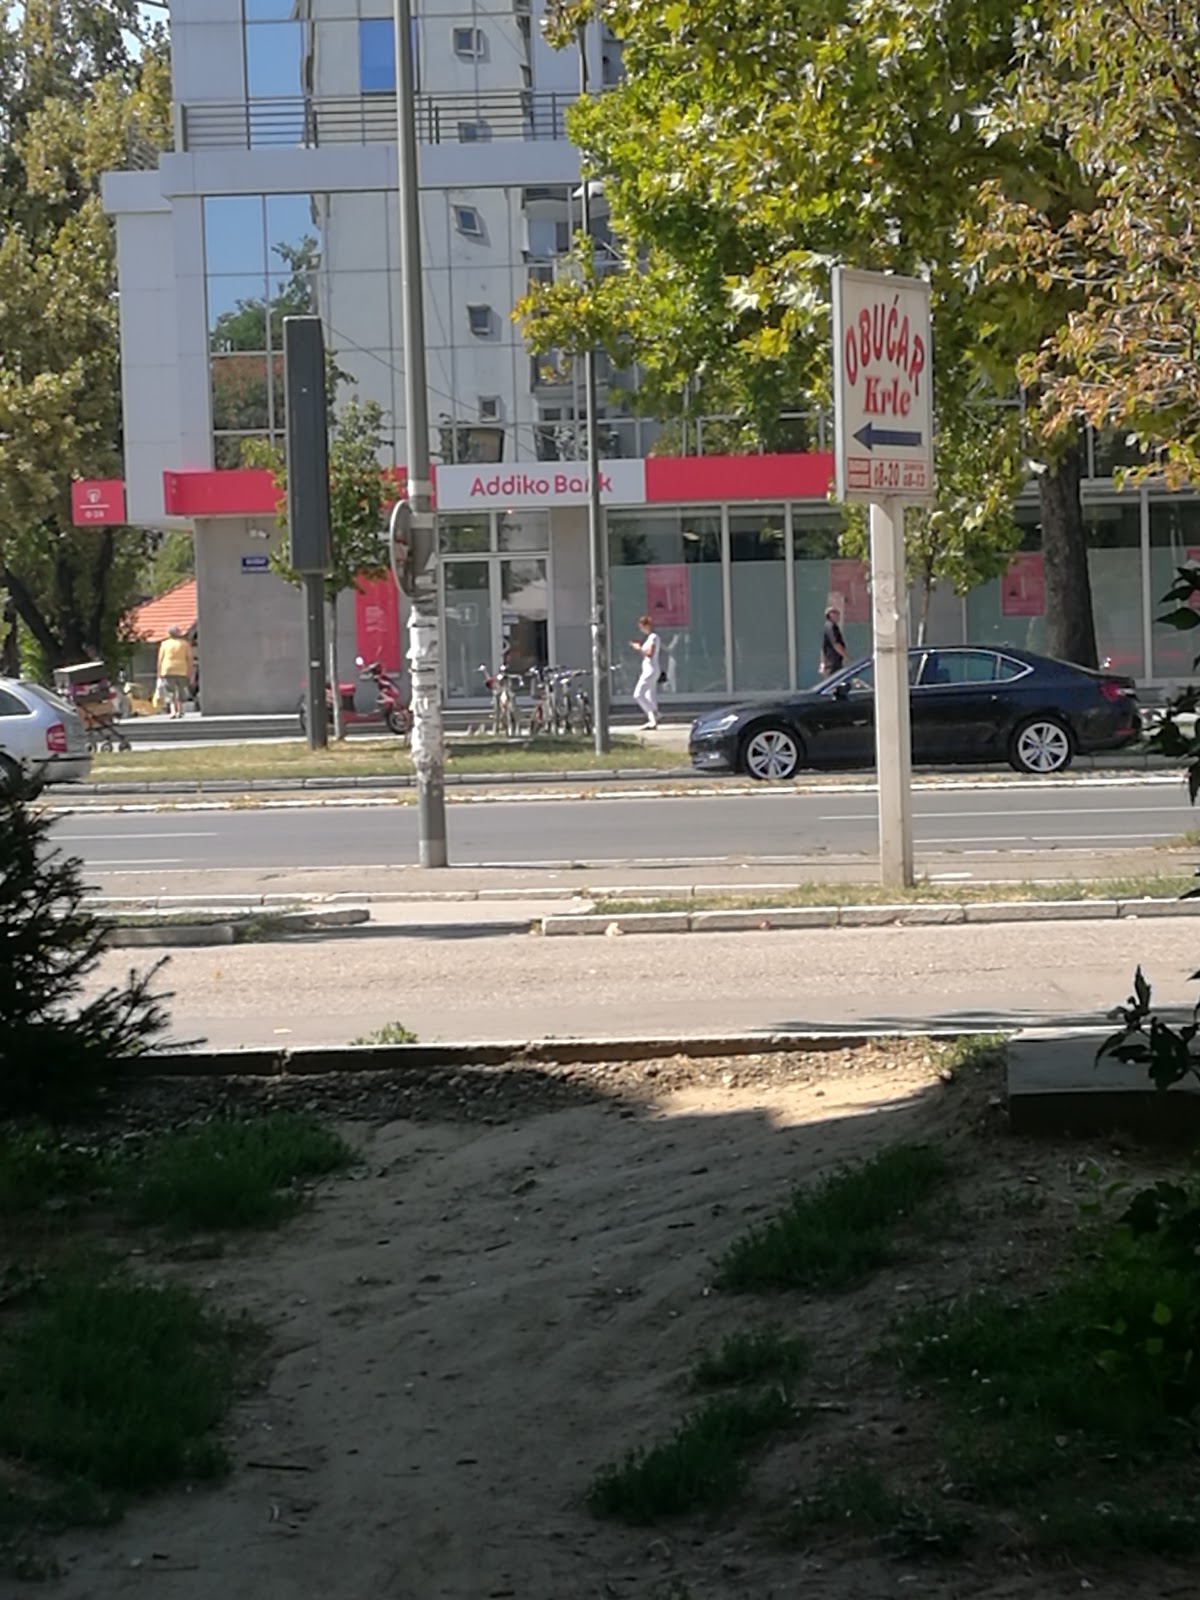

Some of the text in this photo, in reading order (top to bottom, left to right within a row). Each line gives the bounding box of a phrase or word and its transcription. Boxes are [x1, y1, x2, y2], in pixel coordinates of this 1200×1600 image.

[845, 294, 925, 396] OBUĆAR
[863, 375, 911, 416] Krle
[470, 475, 549, 496] Addiko
